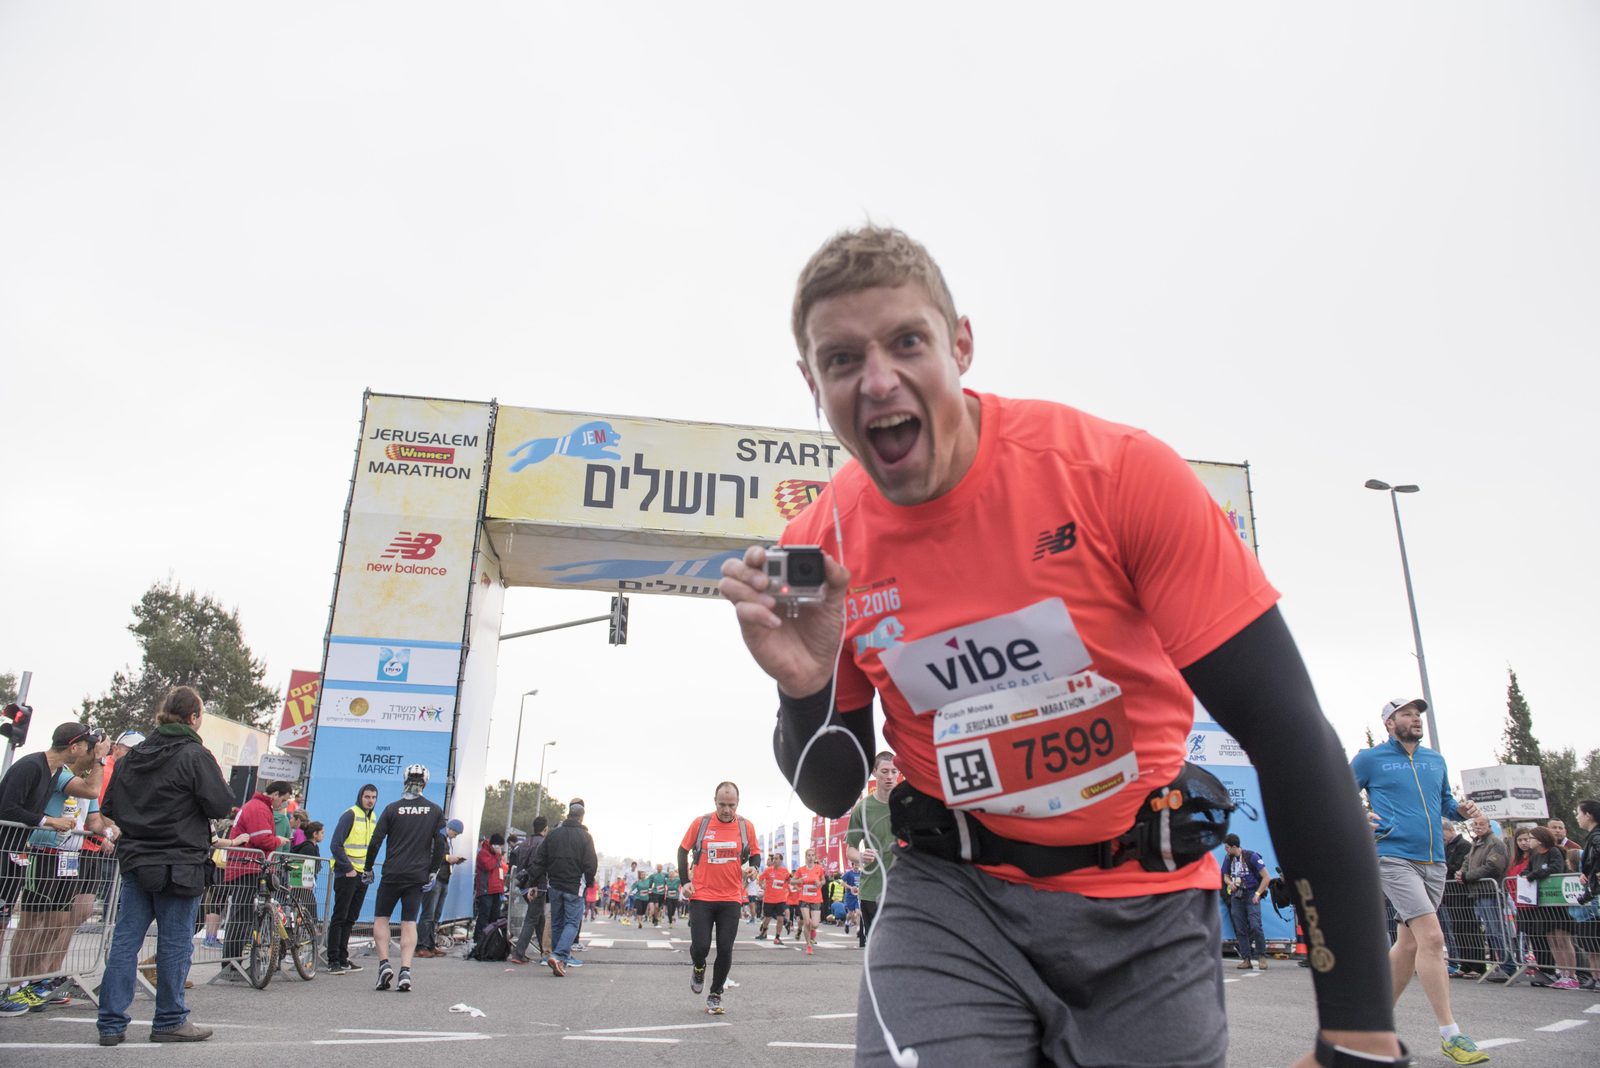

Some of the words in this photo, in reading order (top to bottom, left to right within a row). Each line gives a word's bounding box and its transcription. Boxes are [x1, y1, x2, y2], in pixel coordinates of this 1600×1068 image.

[369, 427, 479, 448] JERUSALEM
[581, 428, 607, 446] JEM
[399, 446, 451, 461] Winner
[736, 437, 841, 469] START
[367, 460, 471, 480] MARATHON
[583, 452, 759, 518] ירושלים
[366, 562, 391, 574] new
[394, 561, 448, 576] balance
[618, 579, 720, 596] ושלים
[925, 636, 1043, 692] vibe
[389, 704, 417, 713] משרד
[943, 709, 966, 720] Coach
[967, 703, 994, 714] Moose
[965, 714, 1010, 734] JERUSALEM
[1040, 696, 1087, 716] MARATHON
[1011, 717, 1115, 781] 7599
[359, 753, 404, 765] TARGET
[1382, 762, 1428, 771] CRAFT
[357, 763, 403, 776] MARKET
[398, 806, 431, 815] STAFF
